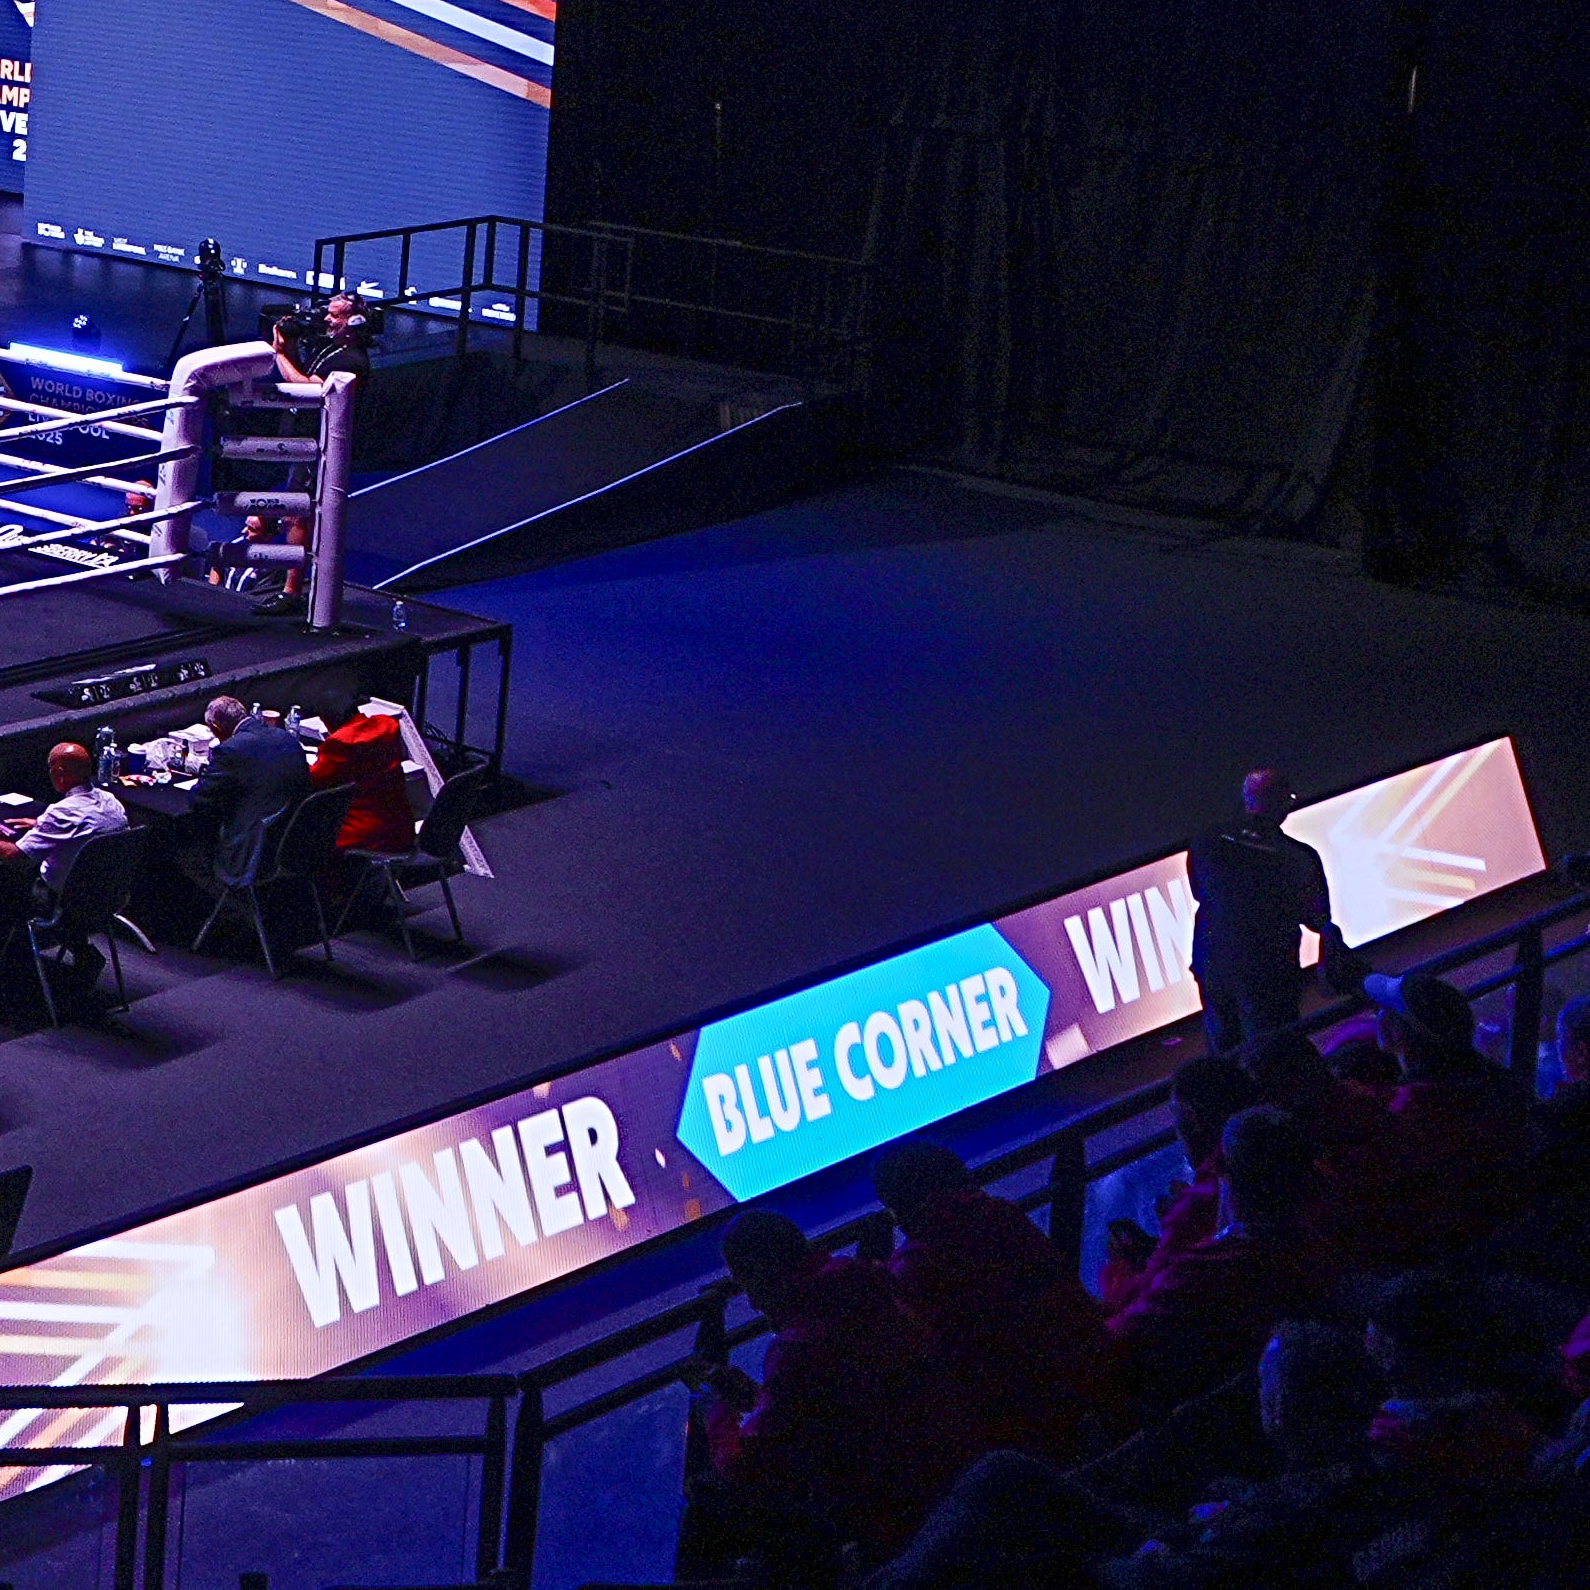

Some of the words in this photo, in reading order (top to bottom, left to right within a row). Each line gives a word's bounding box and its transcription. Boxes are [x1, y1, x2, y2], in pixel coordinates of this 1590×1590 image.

[30, 376, 82, 399] WORLD
[700, 1058, 832, 1157] BLUE
[832, 965, 1029, 1103] CORNER
[273, 1096, 636, 1329] WINNER
